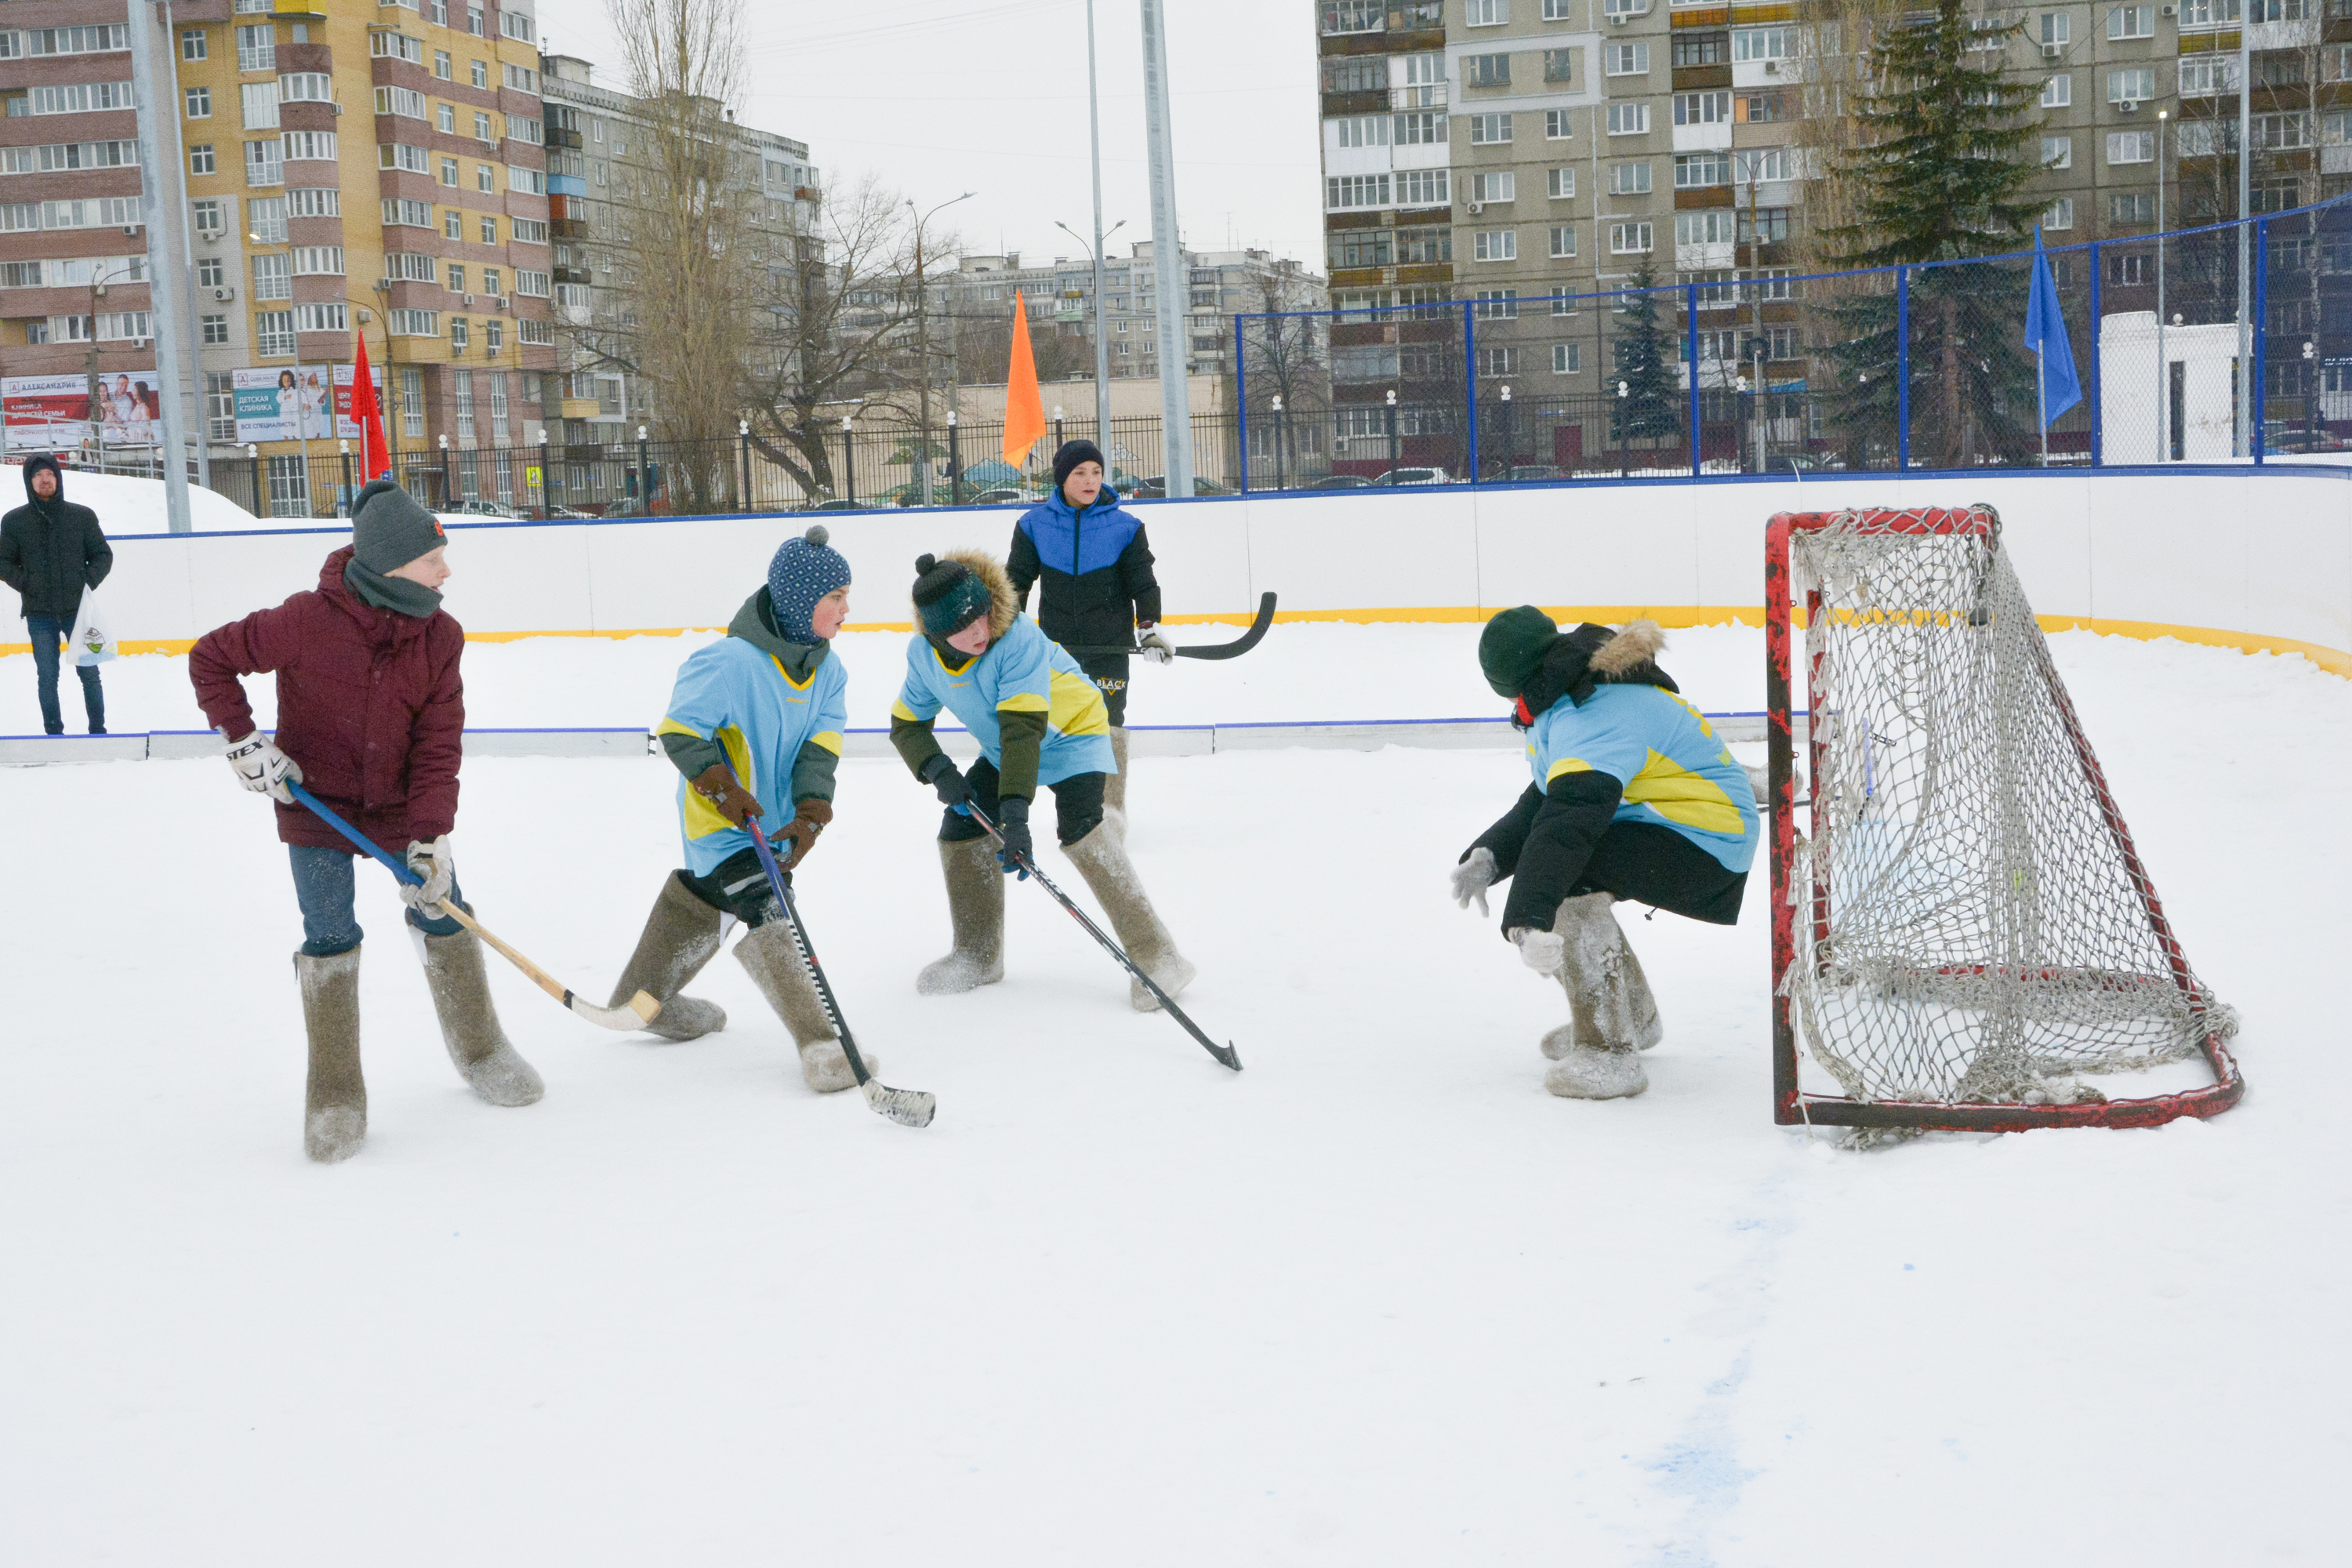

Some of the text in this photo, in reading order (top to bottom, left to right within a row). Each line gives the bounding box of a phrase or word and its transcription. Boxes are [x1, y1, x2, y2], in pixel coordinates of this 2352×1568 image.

[22, 382, 76, 390] АЛЕКСАНДРИЯ
[238, 395, 269, 404] ДЕТСКАЯ
[1096, 679, 1127, 688] BLACK
[226, 738, 263, 761] STEX
